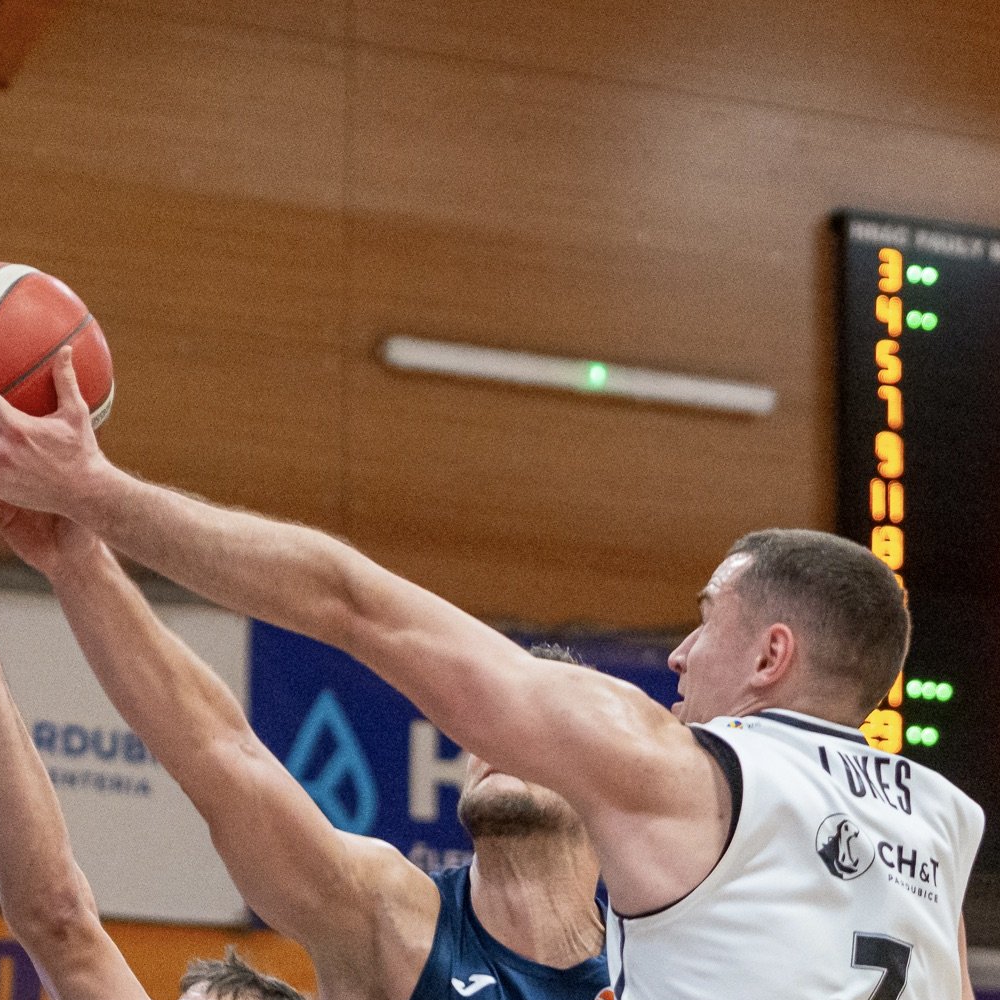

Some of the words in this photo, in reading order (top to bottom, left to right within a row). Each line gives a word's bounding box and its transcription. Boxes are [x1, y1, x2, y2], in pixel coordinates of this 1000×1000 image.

[878, 247, 903, 293] 3
[875, 294, 903, 338] 4
[875, 339, 902, 385] 5
[877, 384, 905, 430] 7
[869, 477, 905, 524] 11
[877, 841, 940, 888] CH&T
